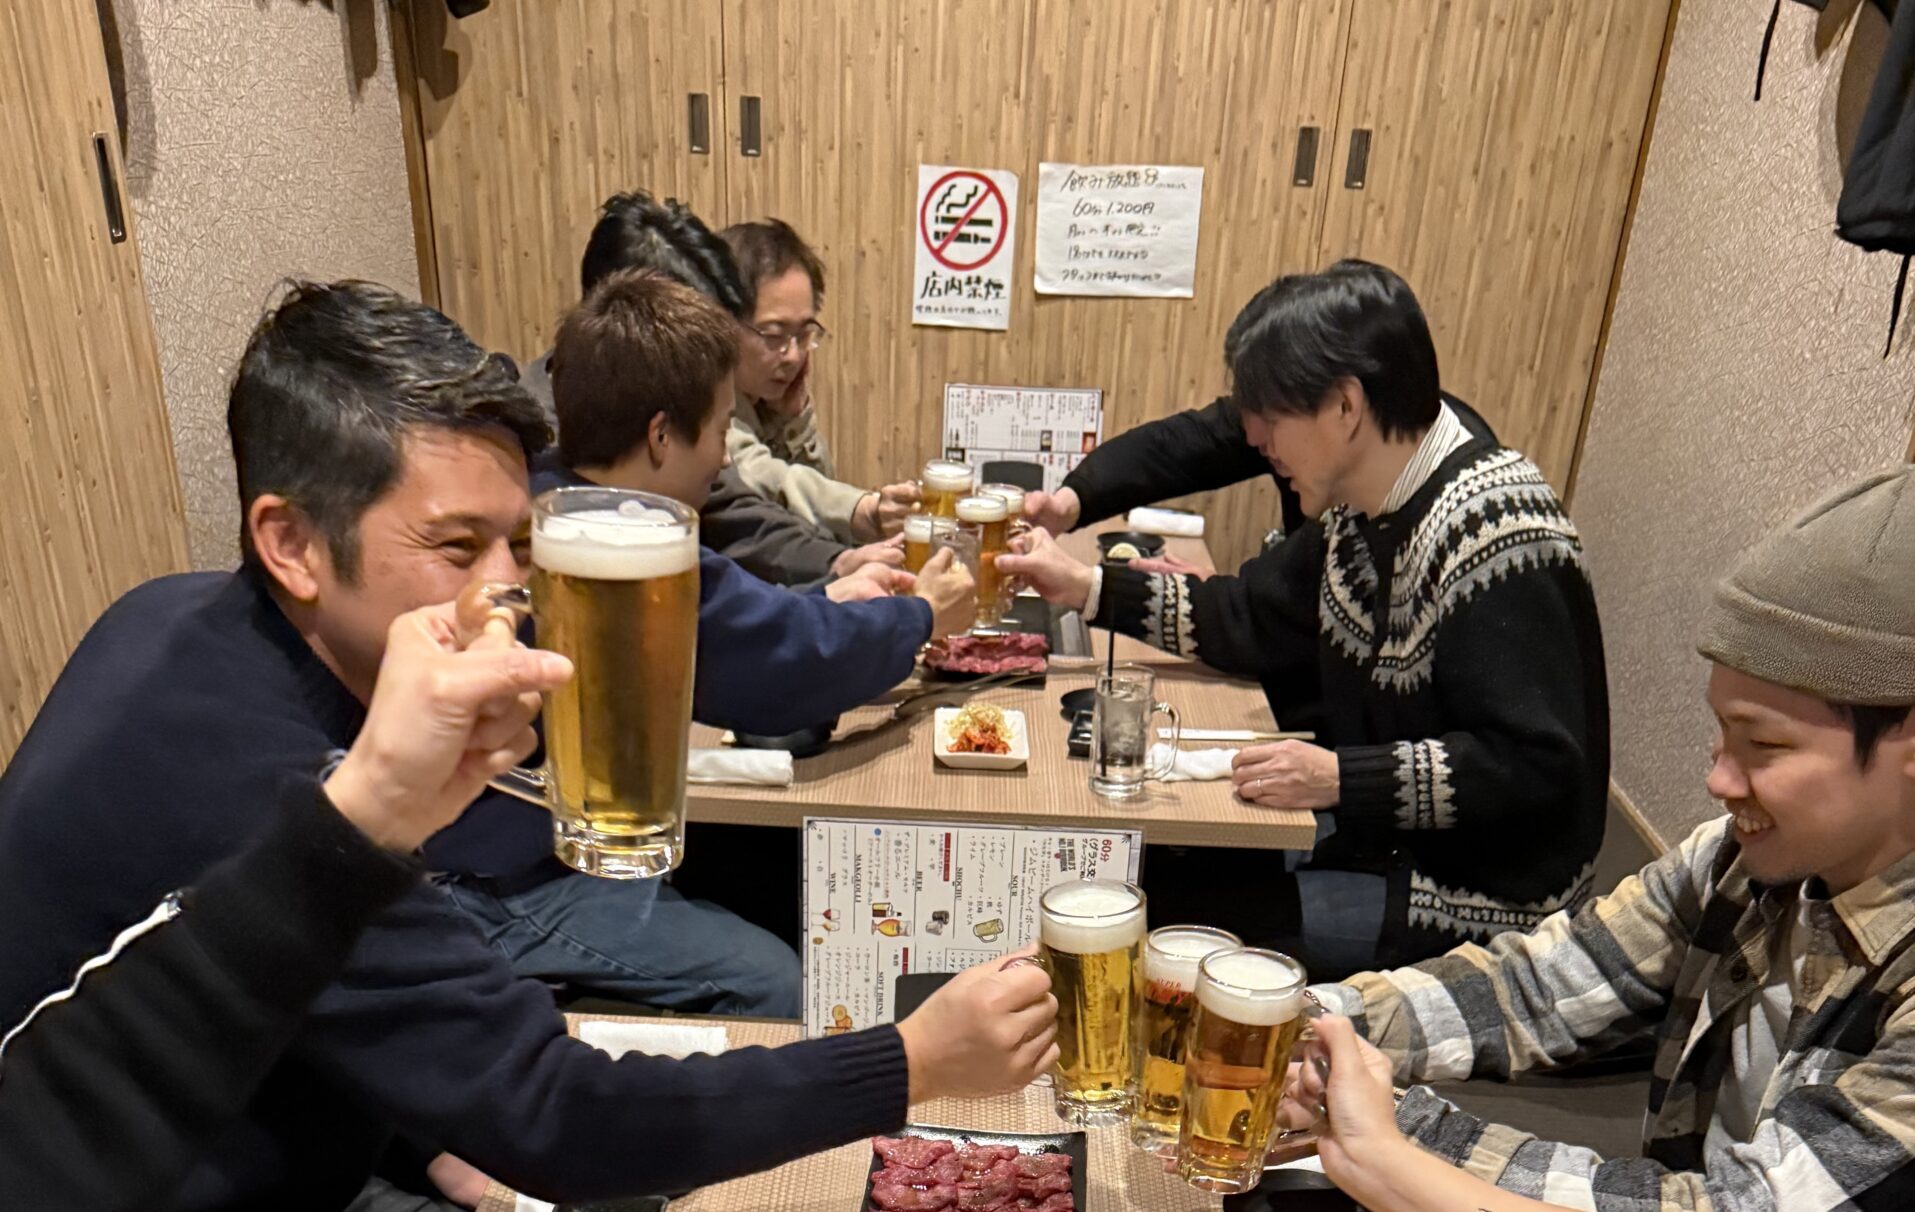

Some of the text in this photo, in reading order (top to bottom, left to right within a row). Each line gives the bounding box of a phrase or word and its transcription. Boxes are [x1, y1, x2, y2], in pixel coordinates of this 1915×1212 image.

[920, 270, 1006, 300] 店内禁煙
[1087, 838, 1098, 879] (グラス交
[1100, 839, 1112, 862] 60分
[955, 867, 963, 901] SHOCHU
[1025, 847, 1038, 942] ジムビームハイボール
[996, 901, 1003, 915] ゆず
[876, 992, 884, 1017] DRINK
